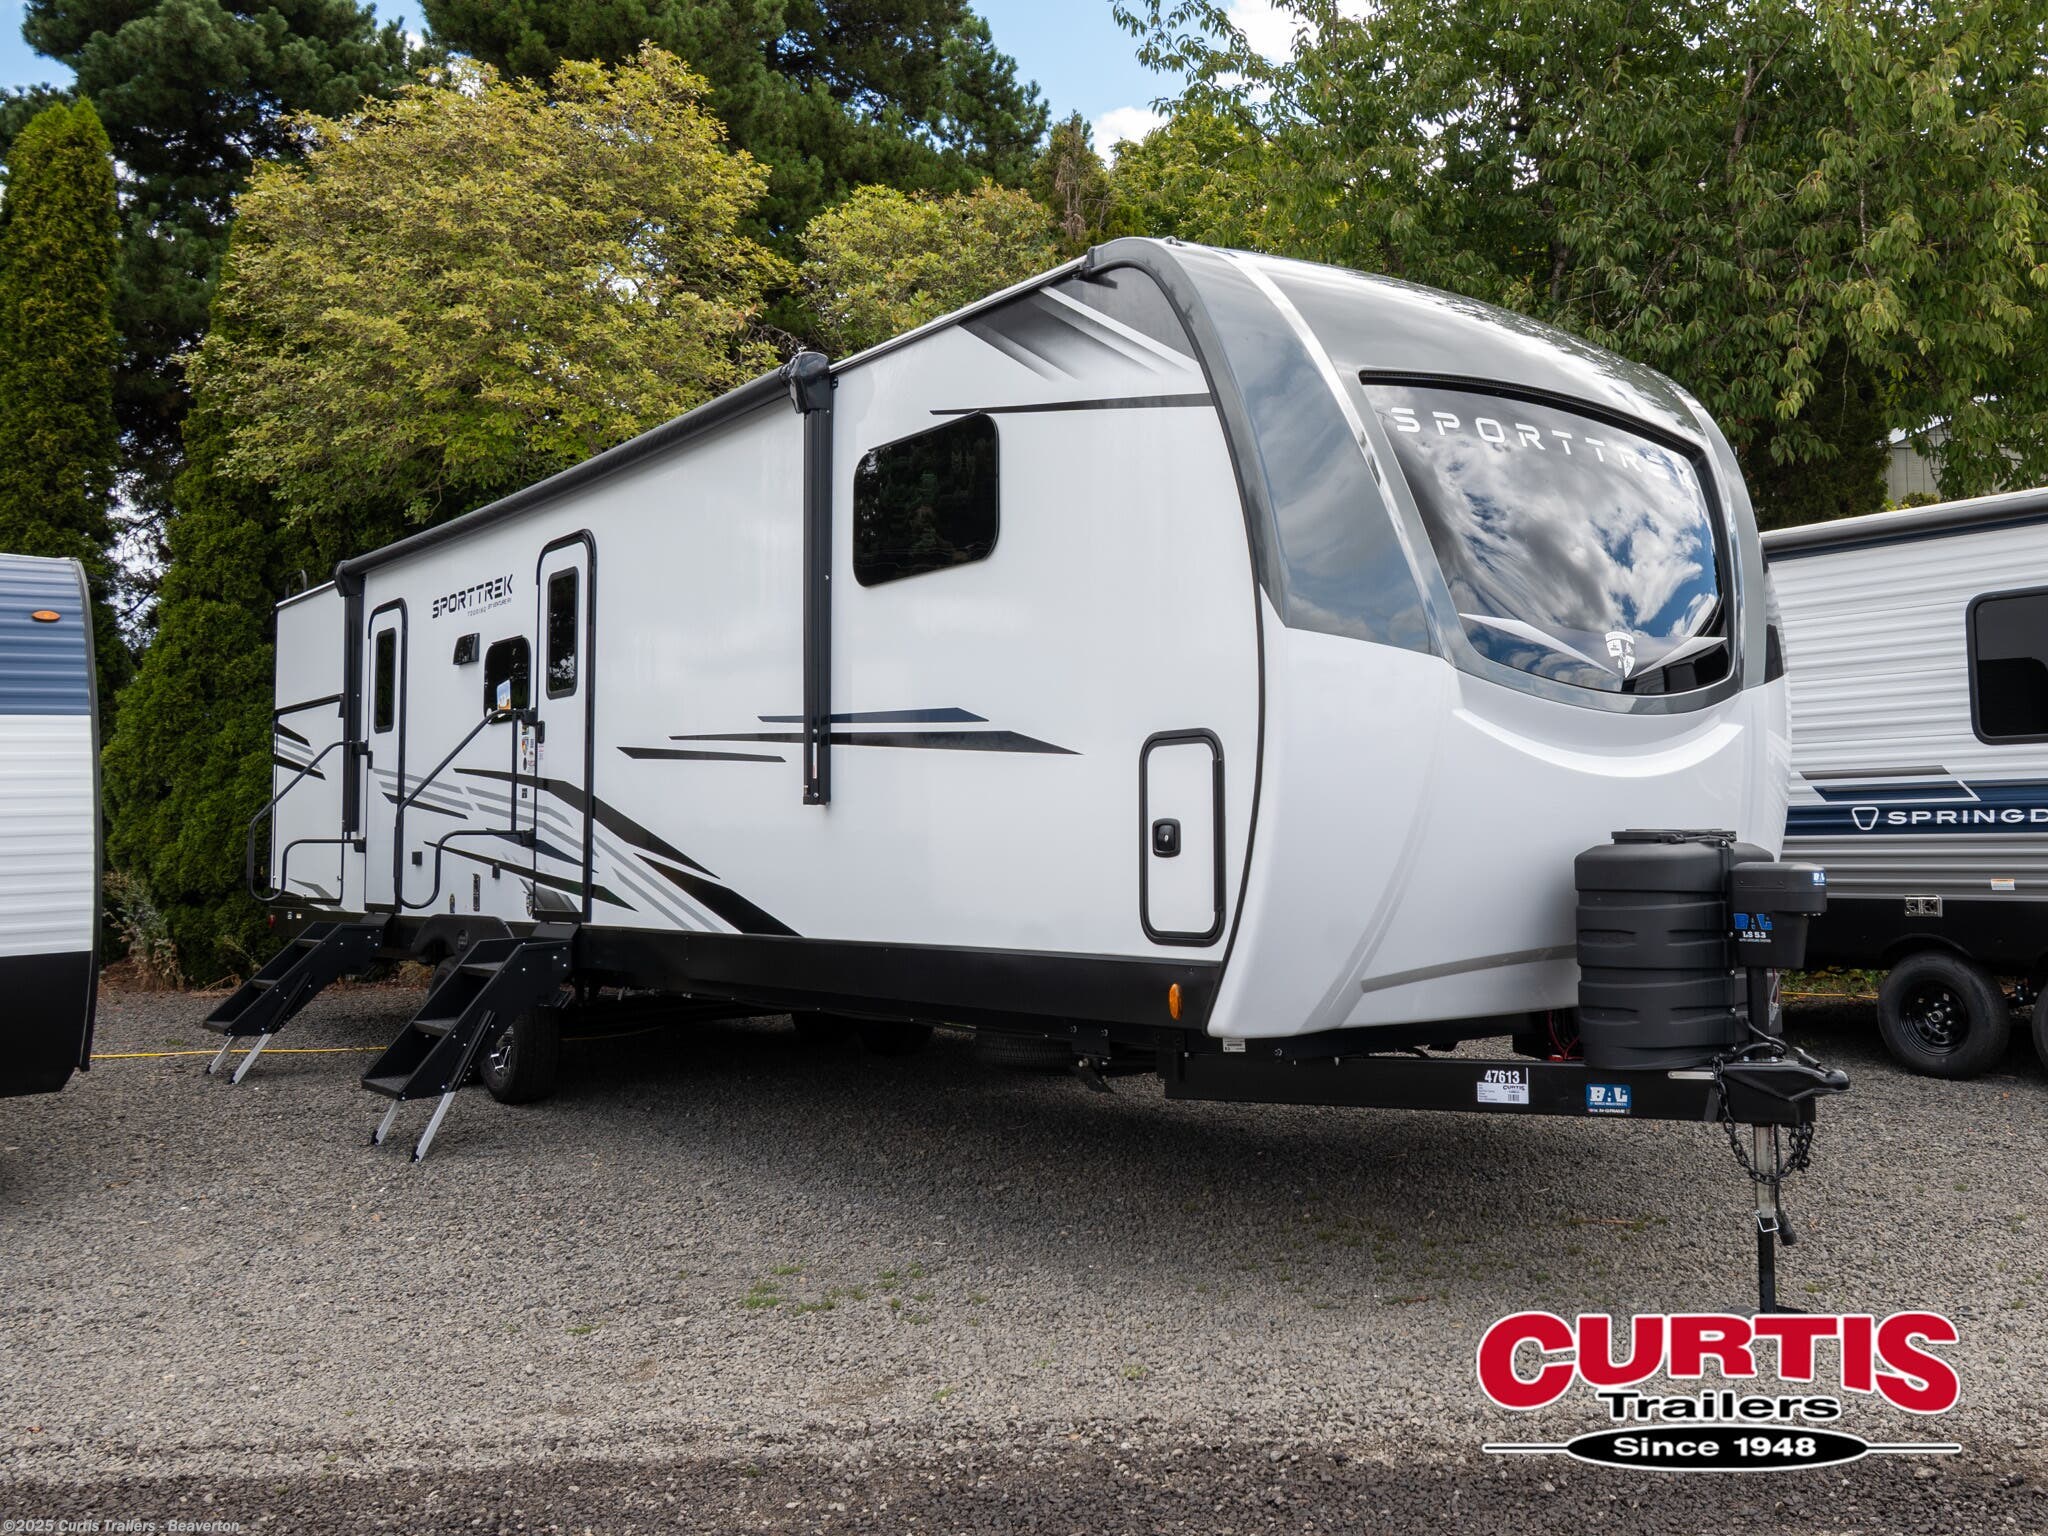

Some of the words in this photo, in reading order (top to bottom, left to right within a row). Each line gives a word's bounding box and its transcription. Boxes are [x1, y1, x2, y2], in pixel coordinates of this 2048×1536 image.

[1390, 407, 1698, 490] SPORTTREK
[432, 574, 513, 618] SPORTTREK
[1484, 1069, 1520, 1084] 47613
